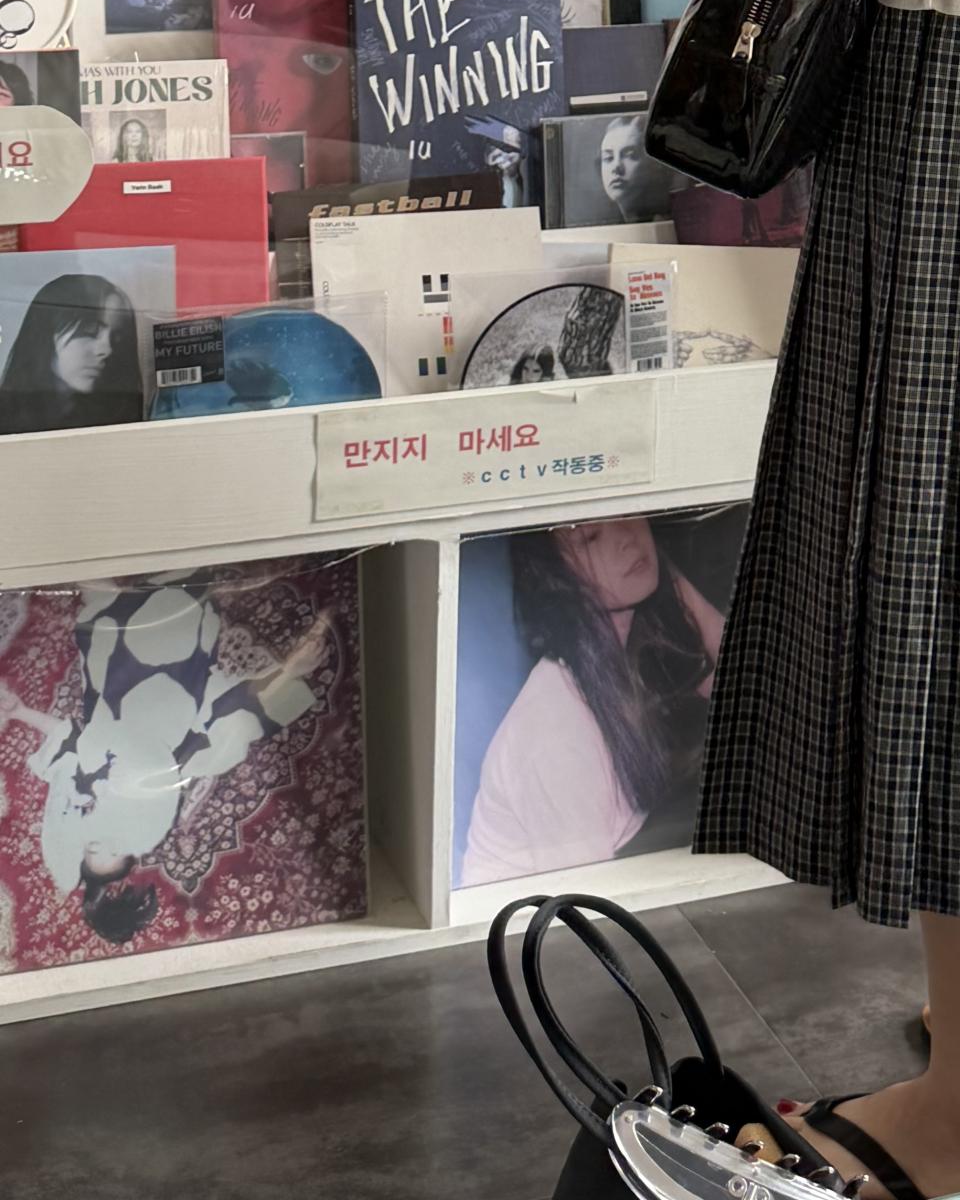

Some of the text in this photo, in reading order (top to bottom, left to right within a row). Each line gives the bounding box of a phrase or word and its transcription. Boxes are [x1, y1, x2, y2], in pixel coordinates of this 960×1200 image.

[105, 65, 134, 77] WITH
[137, 64, 161, 75] YOU
[368, 16, 554, 134] WINNING
[112, 75, 213, 105] JONES
[0, 140, 34, 167] 요
[308, 189, 472, 218] fastball
[154, 327, 189, 339] BILLIE
[155, 347, 173, 358] MY
[175, 340, 223, 357] FUTURE
[343, 423, 540, 468] 만지지 마세요
